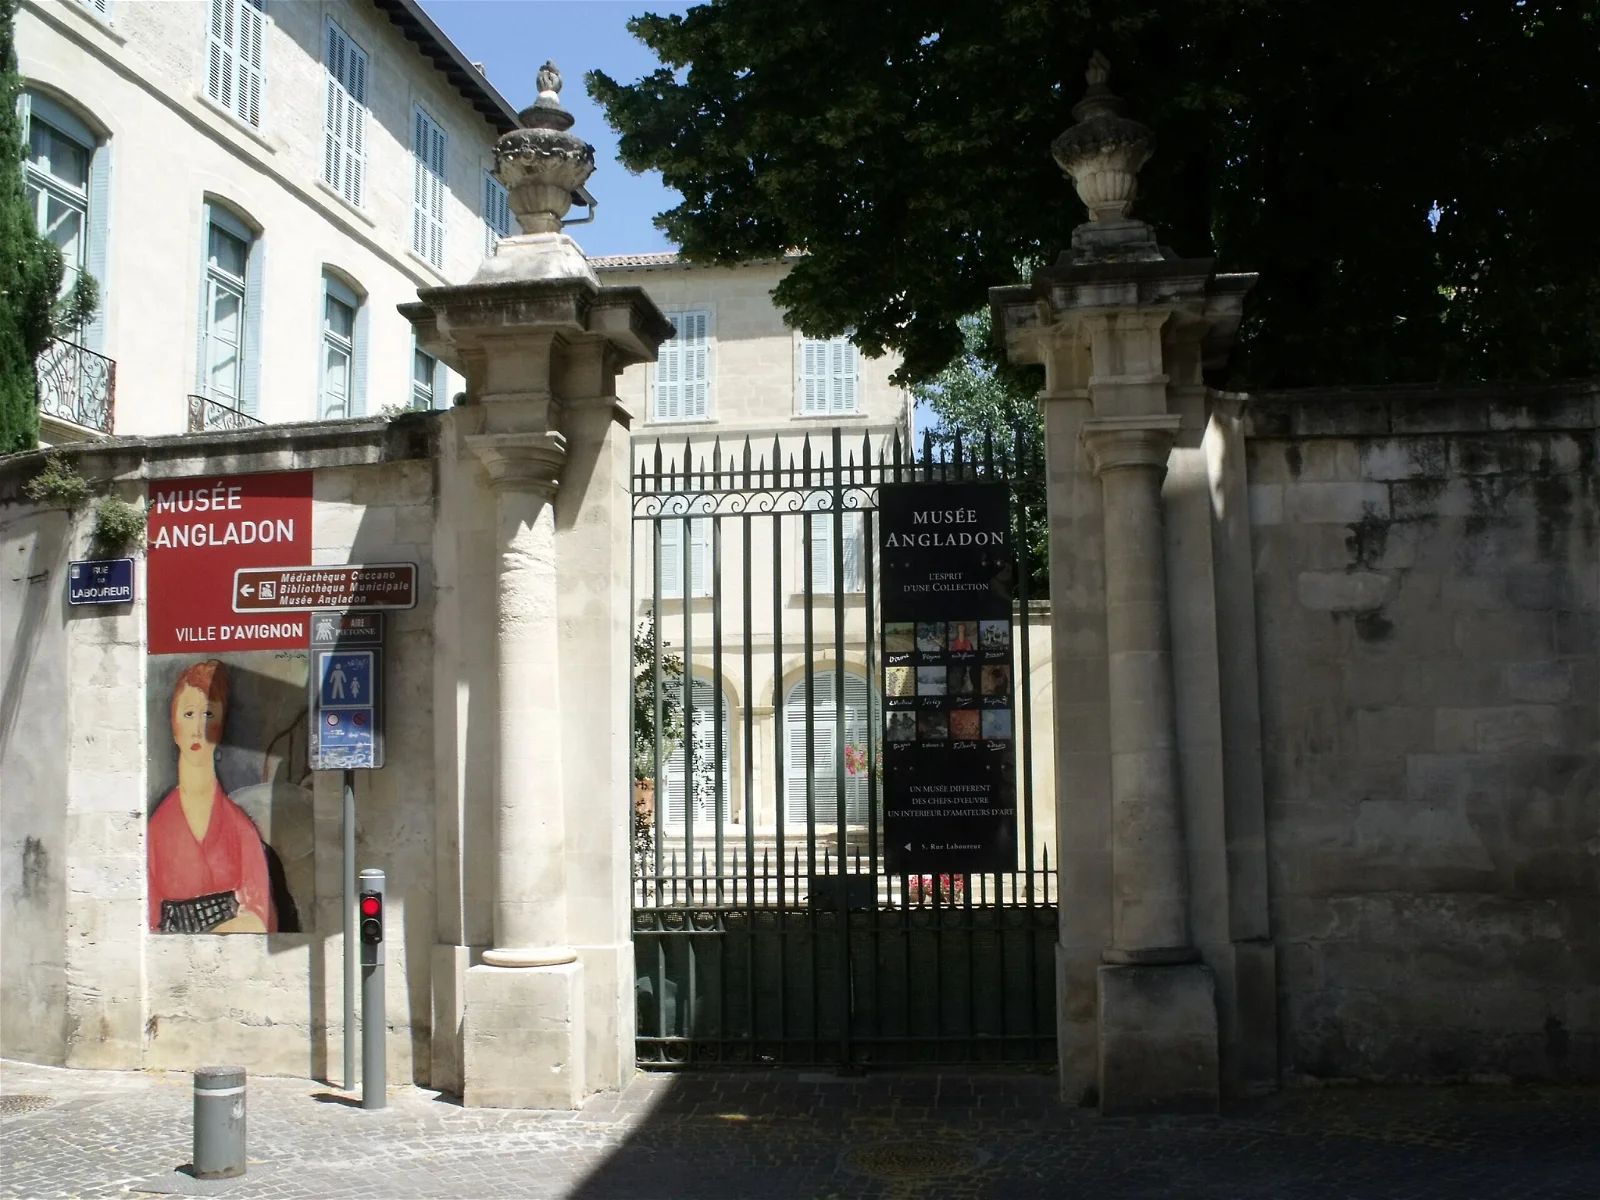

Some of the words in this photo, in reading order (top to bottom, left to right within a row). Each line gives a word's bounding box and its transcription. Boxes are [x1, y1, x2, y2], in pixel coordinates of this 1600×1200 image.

[156, 481, 242, 514] MUSÉE
[913, 508, 977, 524] MUSÉE
[155, 519, 294, 549] ANGLADON
[885, 532, 1004, 548] ANGLADON
[92, 566, 109, 574] RUE
[280, 572, 346, 584] Médiathèque
[351, 571, 396, 581] Ceccano
[929, 573, 964, 581] L'ESPRIT
[72, 586, 130, 598] LABOUREUR
[280, 584, 345, 595] Bibliothèque
[349, 581, 409, 592] Municipale
[903, 584, 930, 592] D'UNE
[279, 595, 312, 605] Musée
[317, 594, 367, 605] Angladon
[175, 626, 217, 642] VILLE
[220, 623, 303, 640] D'AVIGNON
[912, 797, 926, 805] DES
[943, 809, 990, 817] D'AMATEURS
[991, 808, 1014, 816] D'ART
